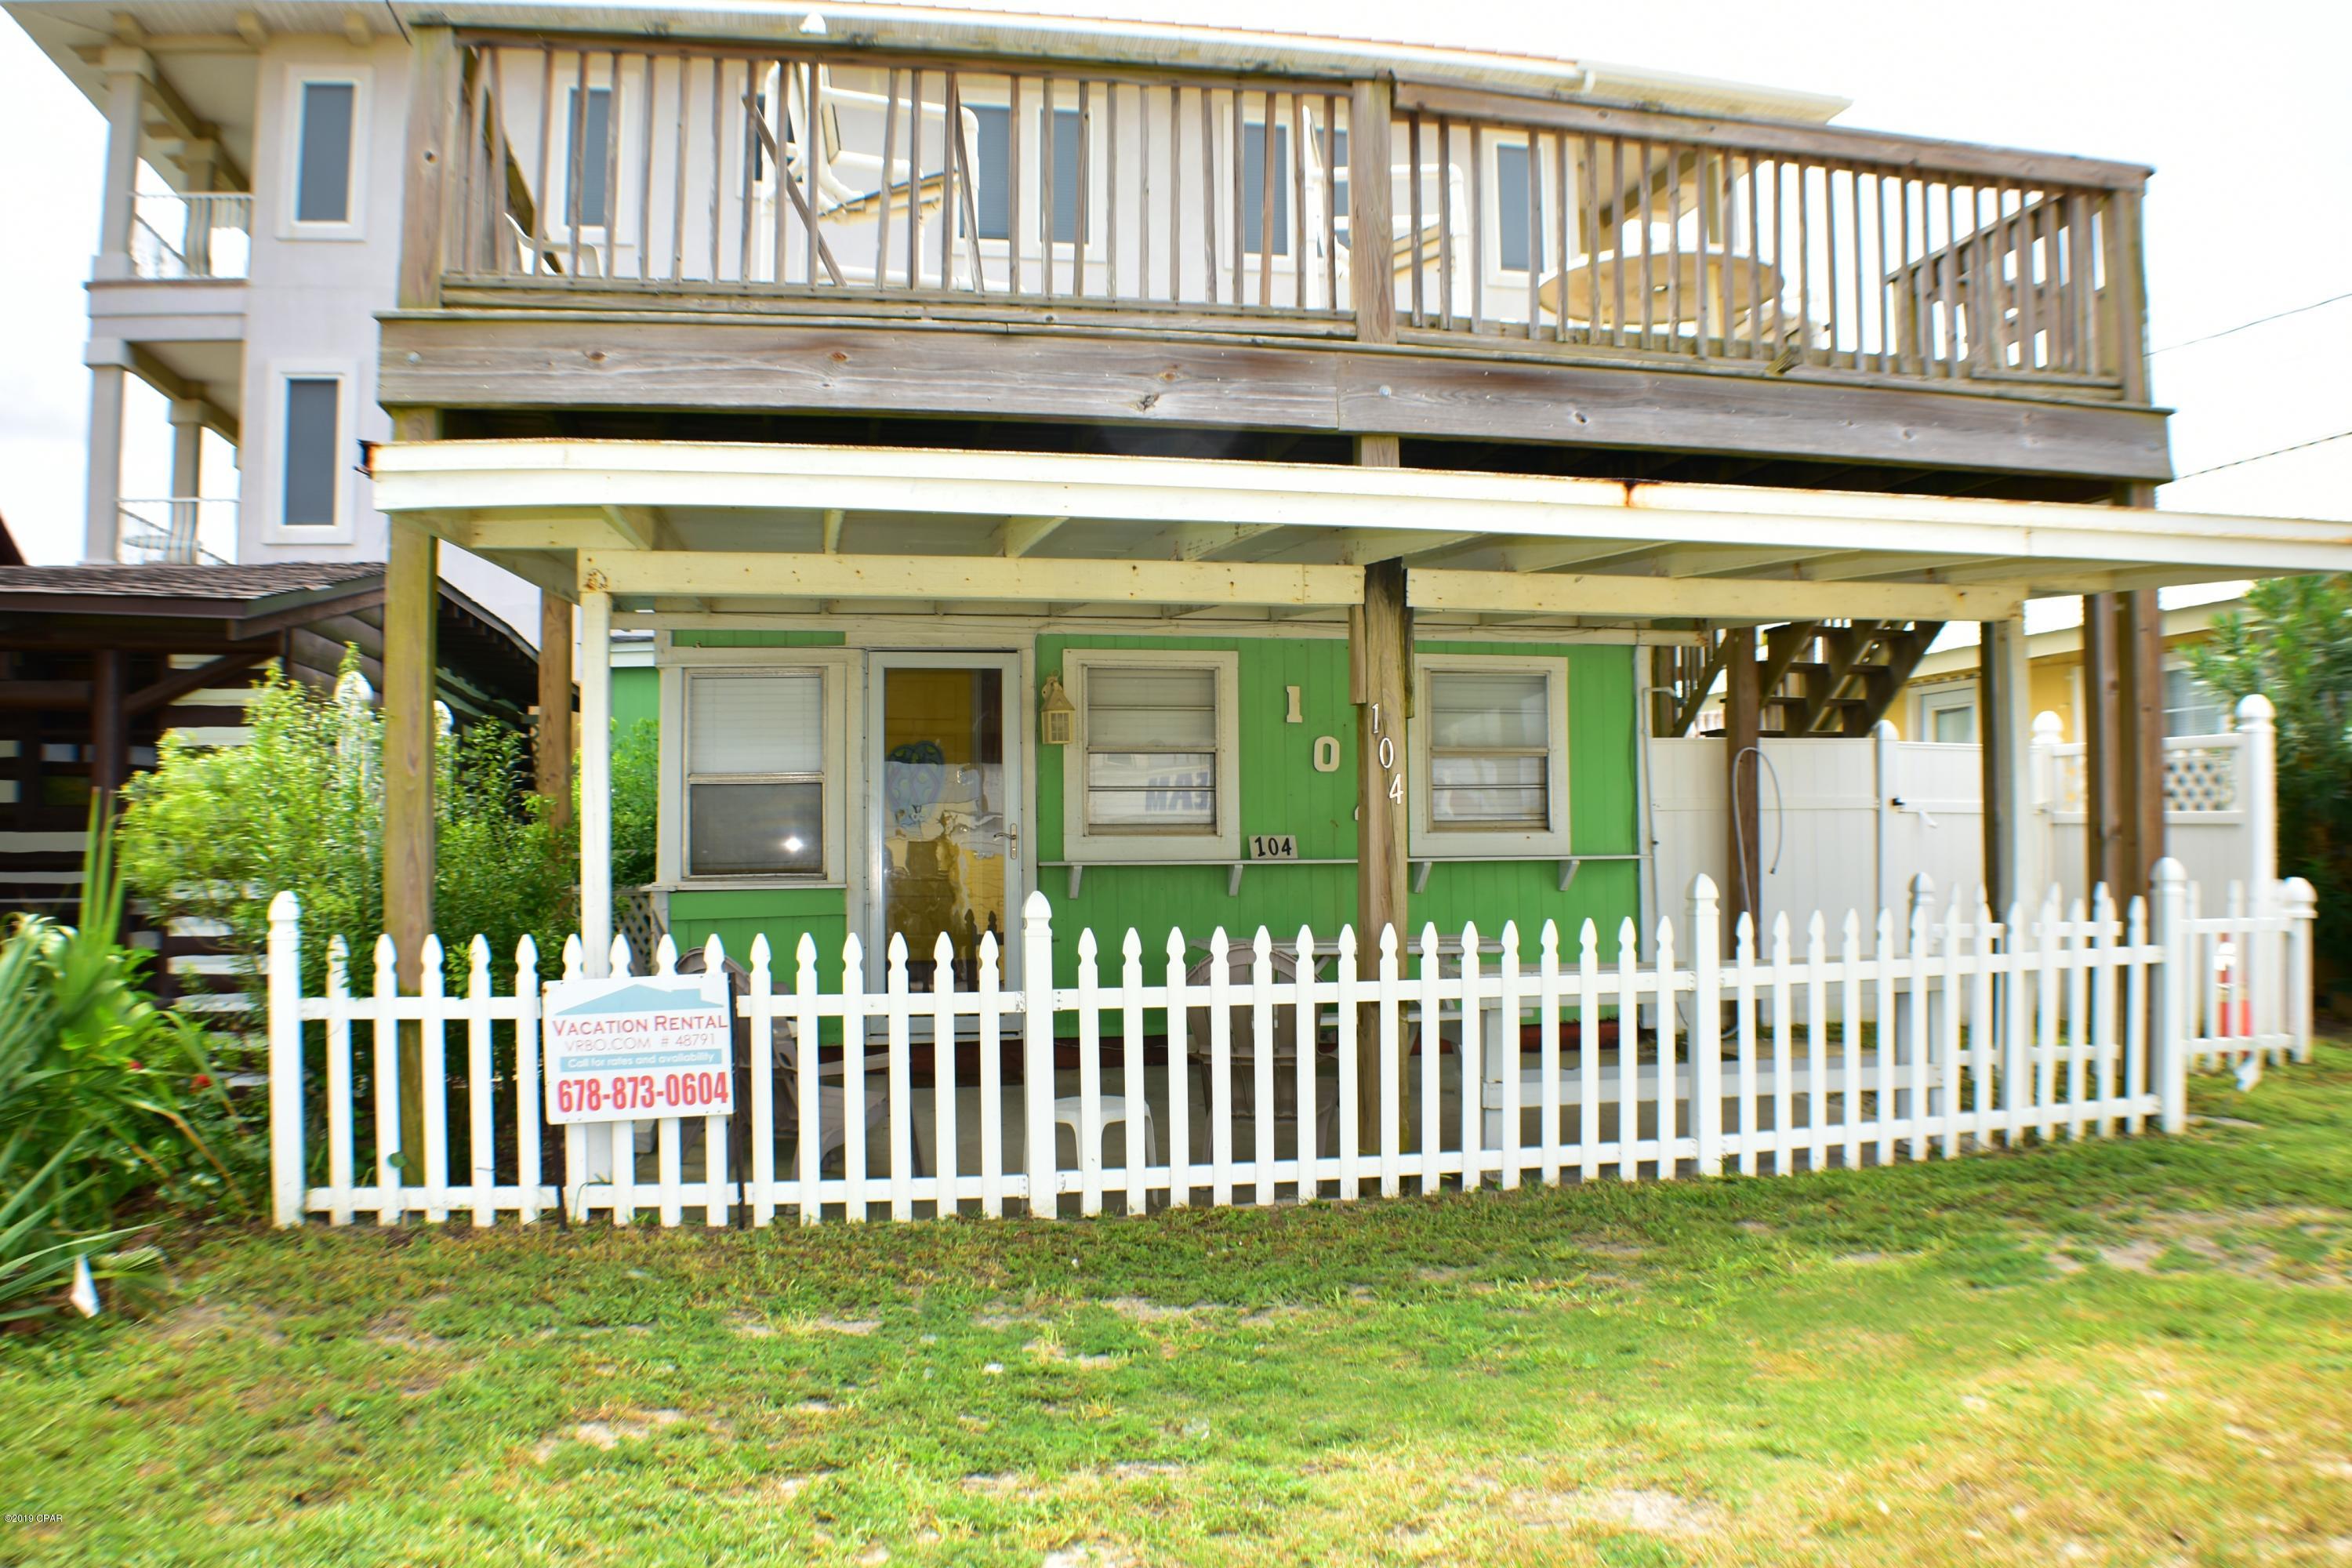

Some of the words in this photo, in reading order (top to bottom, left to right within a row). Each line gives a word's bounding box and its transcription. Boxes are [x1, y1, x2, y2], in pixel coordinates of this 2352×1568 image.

[1254, 836, 1292, 857] 104
[552, 1019, 648, 1036] VACATION
[654, 1015, 728, 1032] RENTAL
[565, 1036, 652, 1052] VRBO.COM
[675, 1033, 715, 1047] 48791
[568, 1058, 589, 1069] Call
[591, 1057, 604, 1067] for
[607, 1055, 633, 1066] rates
[635, 1054, 656, 1065] and
[658, 1050, 715, 1063] availability
[558, 1072, 728, 1112] 678-873-0604
